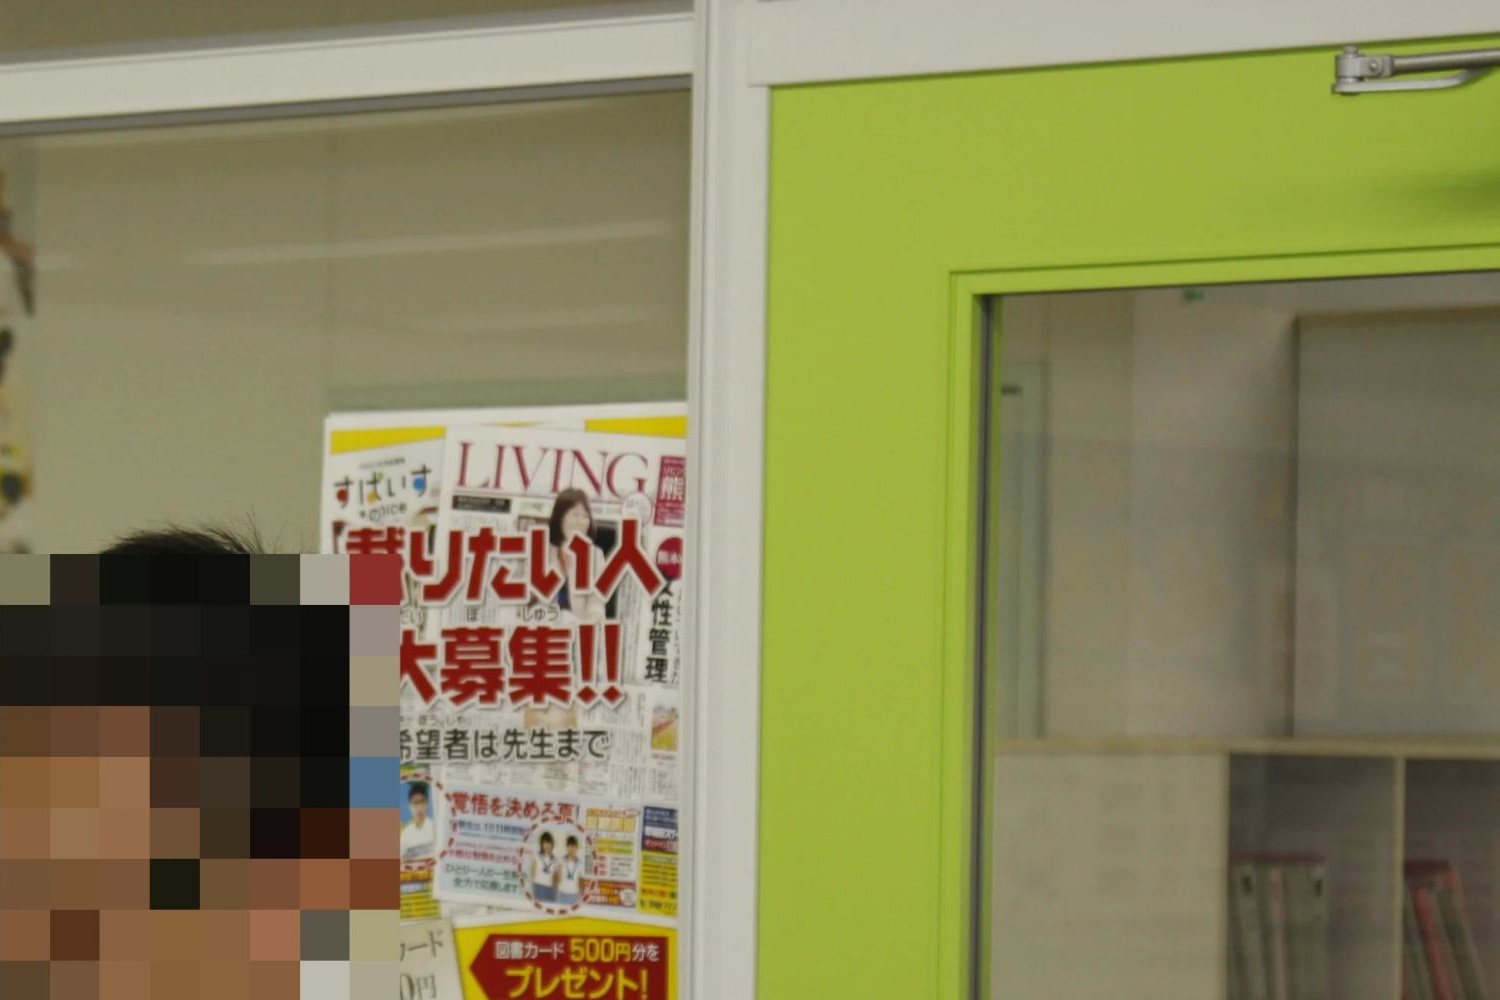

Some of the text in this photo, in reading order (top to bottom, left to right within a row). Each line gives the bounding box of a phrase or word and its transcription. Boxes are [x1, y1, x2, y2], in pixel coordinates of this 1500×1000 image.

[456, 441, 649, 499] LIVING
[495, 938, 660, 963] 図書カード 500円分を
